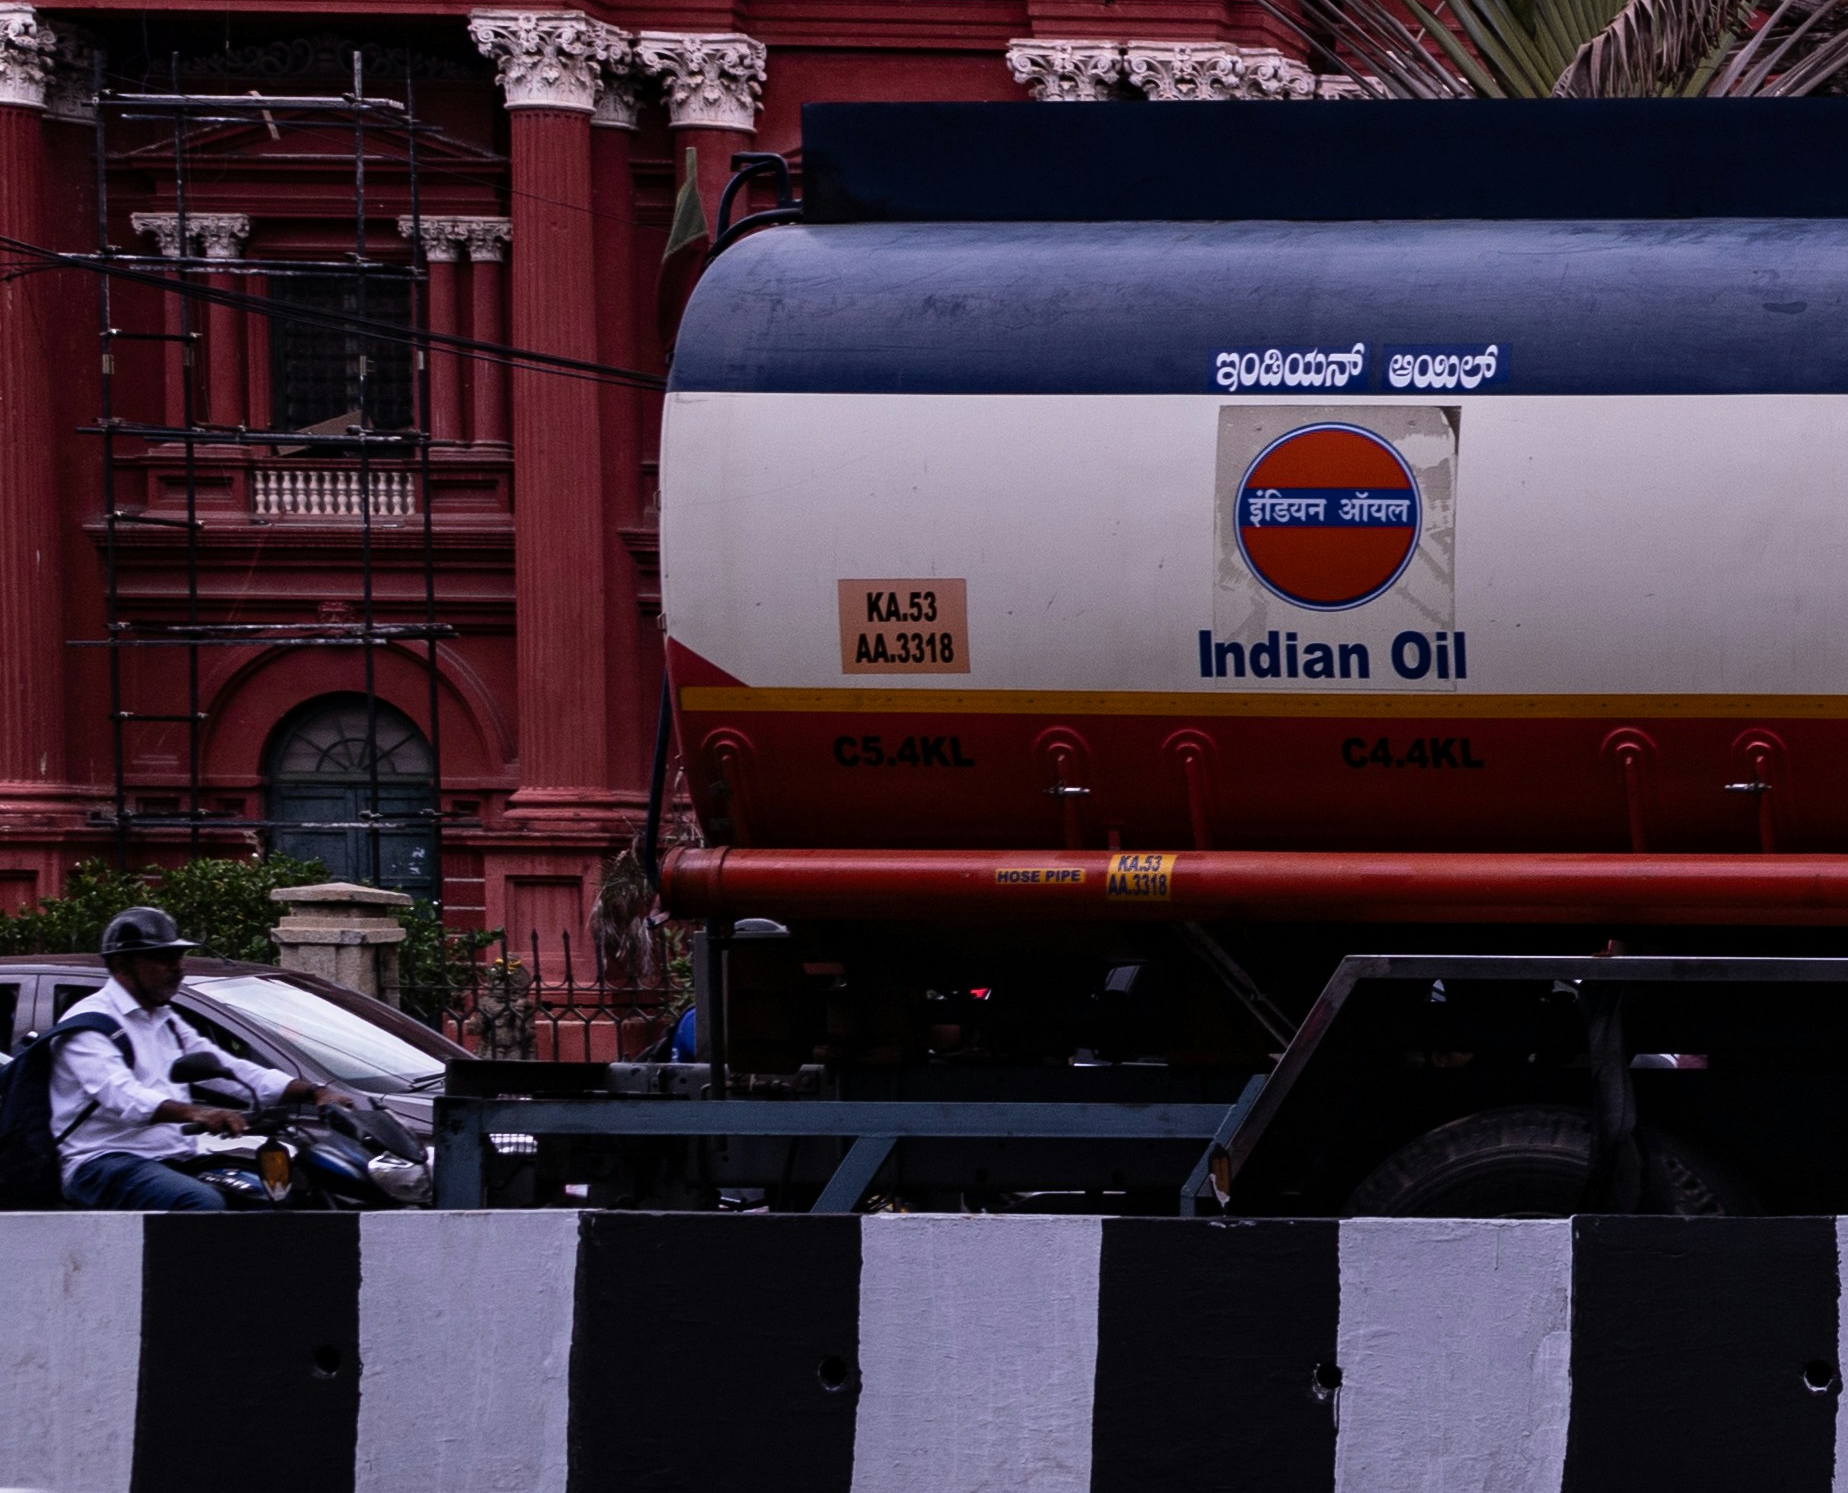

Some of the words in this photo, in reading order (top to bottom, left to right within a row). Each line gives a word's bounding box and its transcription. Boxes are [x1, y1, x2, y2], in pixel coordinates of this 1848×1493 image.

[1216, 343, 1366, 392] ಇಂಡಿಯನ್
[1389, 345, 1499, 389] ಆಯಿಲ್
[1248, 489, 1327, 528] इंडियन
[1338, 491, 1411, 523] ऑयल
[866, 591, 938, 622] KA.53
[856, 632, 954, 663] AA.3318
[1199, 630, 1370, 678] Indian
[1391, 631, 1467, 680] Oil
[833, 736, 976, 767] C5.4KL
[1342, 737, 1485, 768] C4.4KL
[997, 870, 1041, 883] HOSE
[1045, 870, 1081, 882] PIPE
[1117, 855, 1163, 872] KA.53
